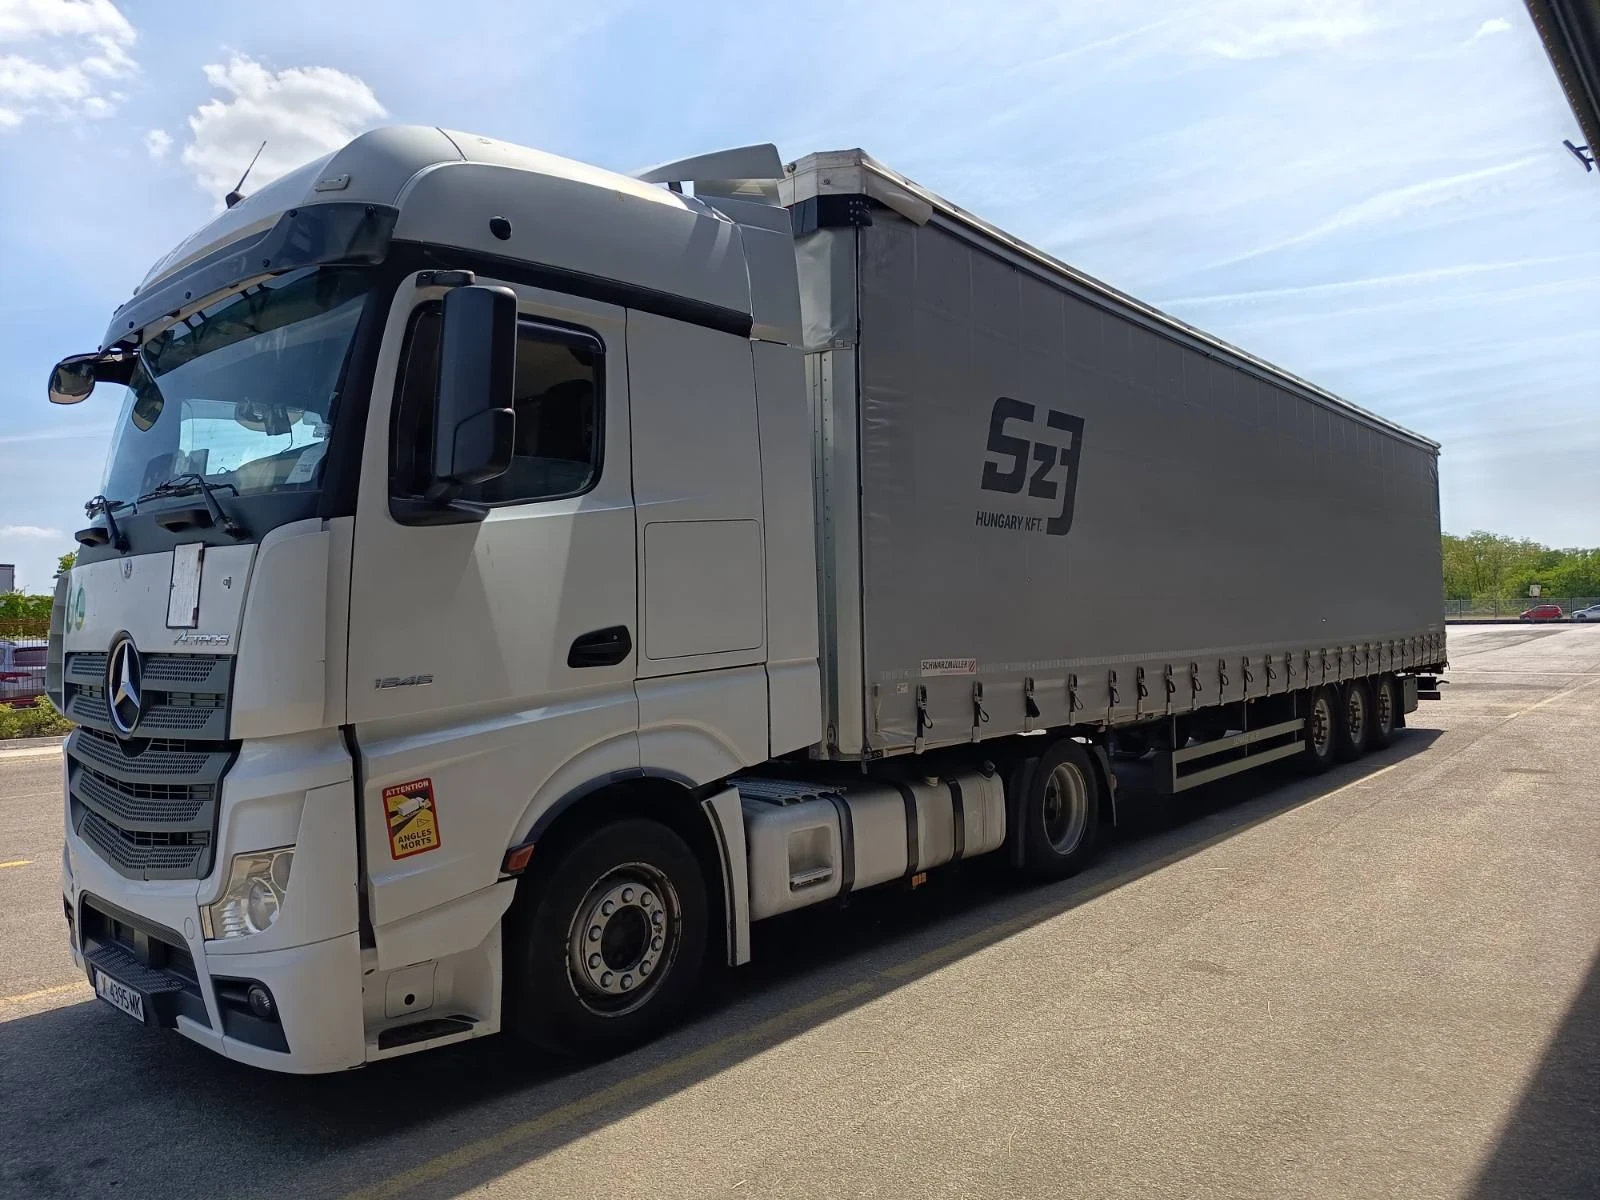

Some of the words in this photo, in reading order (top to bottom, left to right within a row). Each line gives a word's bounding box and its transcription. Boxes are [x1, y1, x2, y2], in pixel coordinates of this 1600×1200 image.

[975, 511, 1024, 530] HUNGARY
[1025, 517, 1043, 533] KFT.
[386, 780, 429, 797] ATTENTION
[398, 829, 432, 844] ANGLES
[400, 837, 432, 851] MORTS
